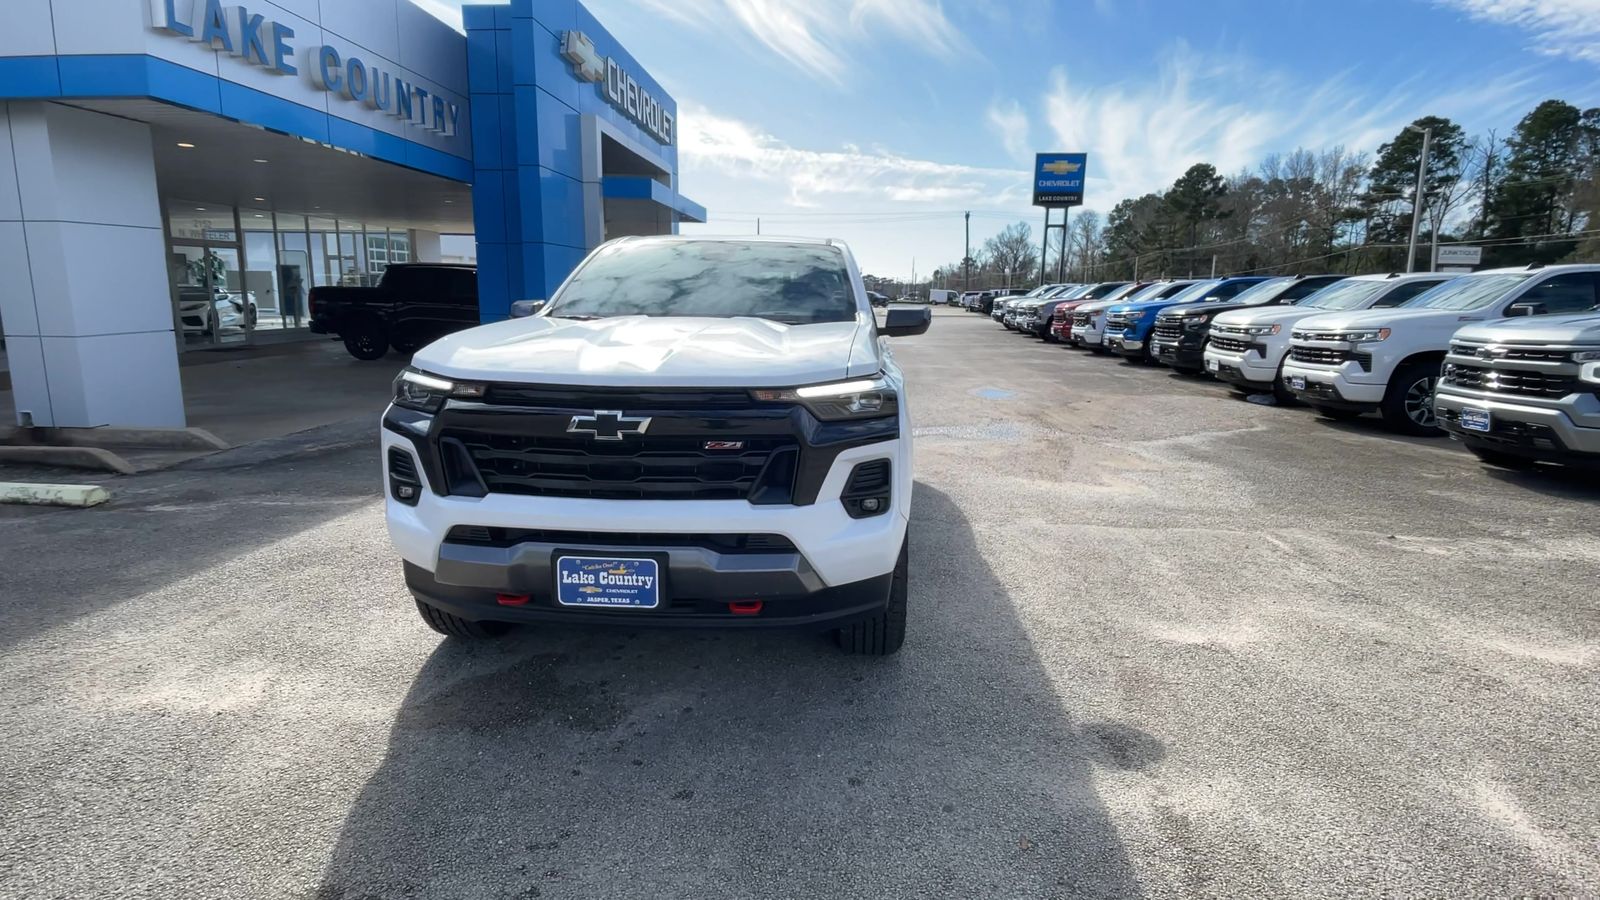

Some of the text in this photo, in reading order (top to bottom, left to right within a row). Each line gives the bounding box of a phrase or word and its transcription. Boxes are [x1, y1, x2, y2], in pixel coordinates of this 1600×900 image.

[152, 0, 459, 136] LAKE COUNTRY
[606, 57, 675, 145] CHEVROLET
[562, 570, 653, 589] Lake Country
